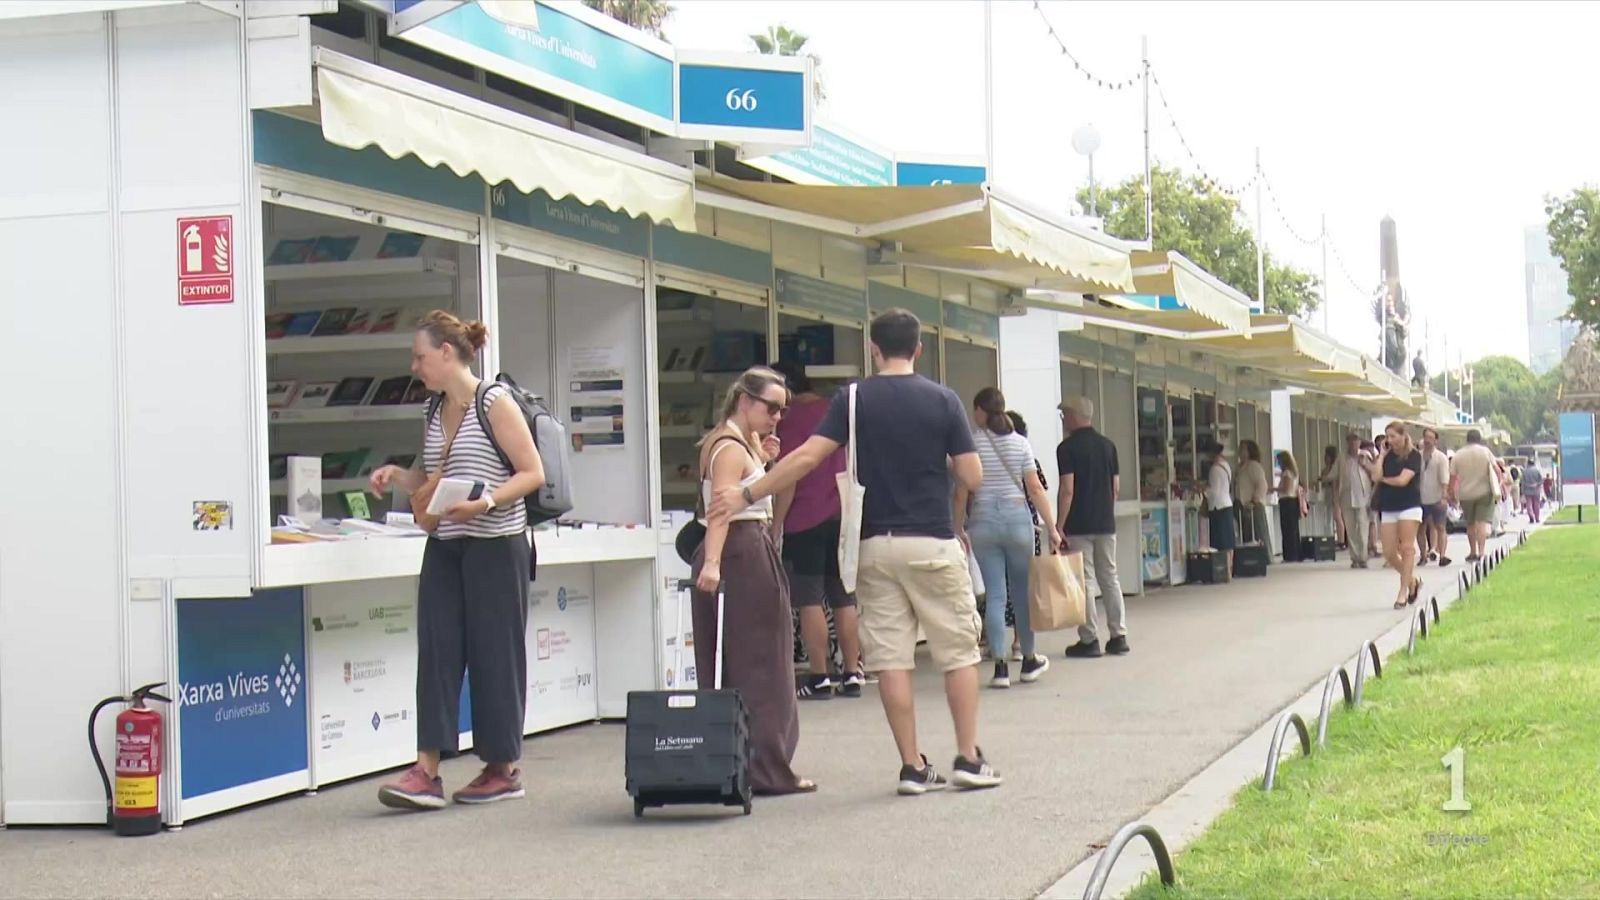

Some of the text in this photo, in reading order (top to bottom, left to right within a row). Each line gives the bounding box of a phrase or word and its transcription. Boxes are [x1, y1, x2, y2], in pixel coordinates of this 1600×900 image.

[527, 29, 548, 50] Vives
[725, 87, 758, 111] 66
[493, 188, 506, 207] 66
[182, 284, 230, 296] EXTINTOR
[368, 607, 385, 621] UAB
[179, 671, 270, 707] Xarxa Vives
[215, 701, 271, 723] d'universitats
[655, 735, 704, 746] La Setmana
